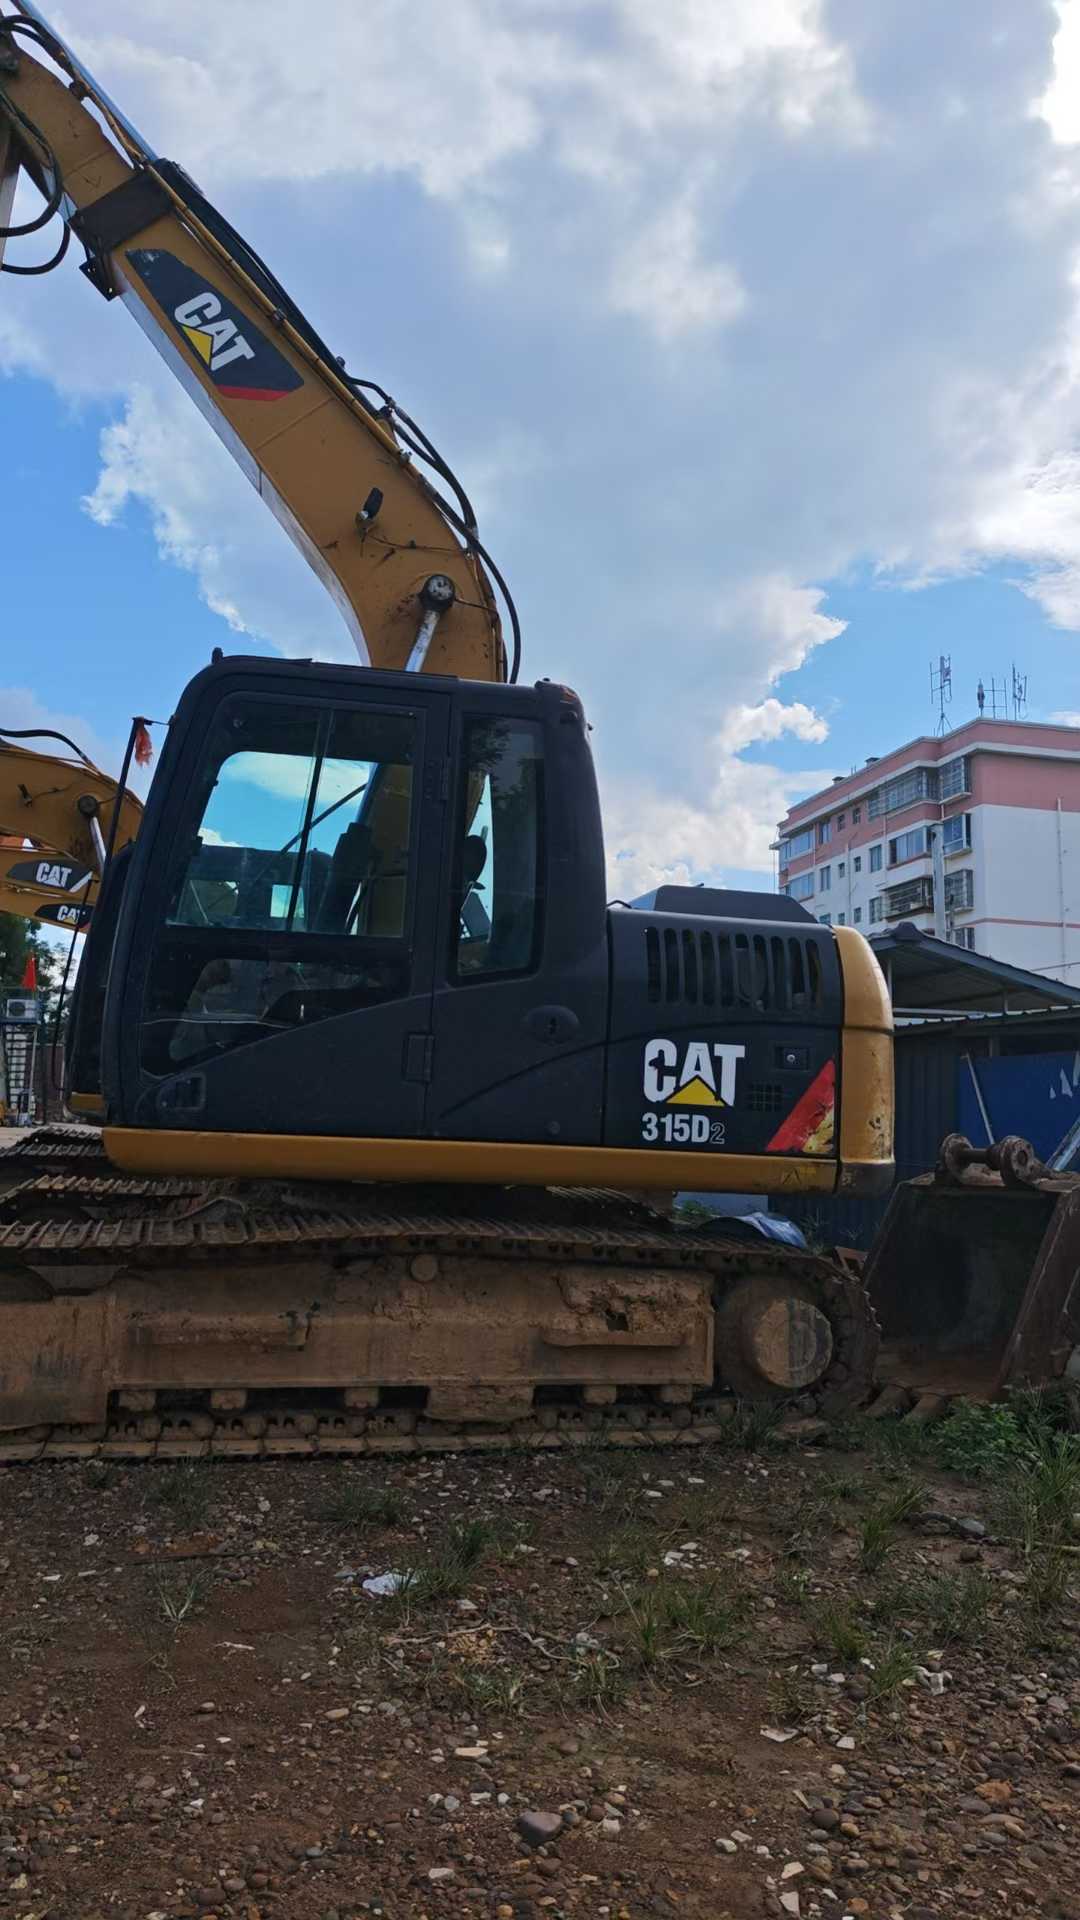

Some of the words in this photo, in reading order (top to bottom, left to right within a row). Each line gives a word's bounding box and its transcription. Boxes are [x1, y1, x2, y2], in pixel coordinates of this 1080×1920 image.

[174, 292, 256, 372] CAT
[36, 862, 72, 888] CAT
[643, 1038, 746, 1107] CAT
[641, 1112, 726, 1145] 315D2
